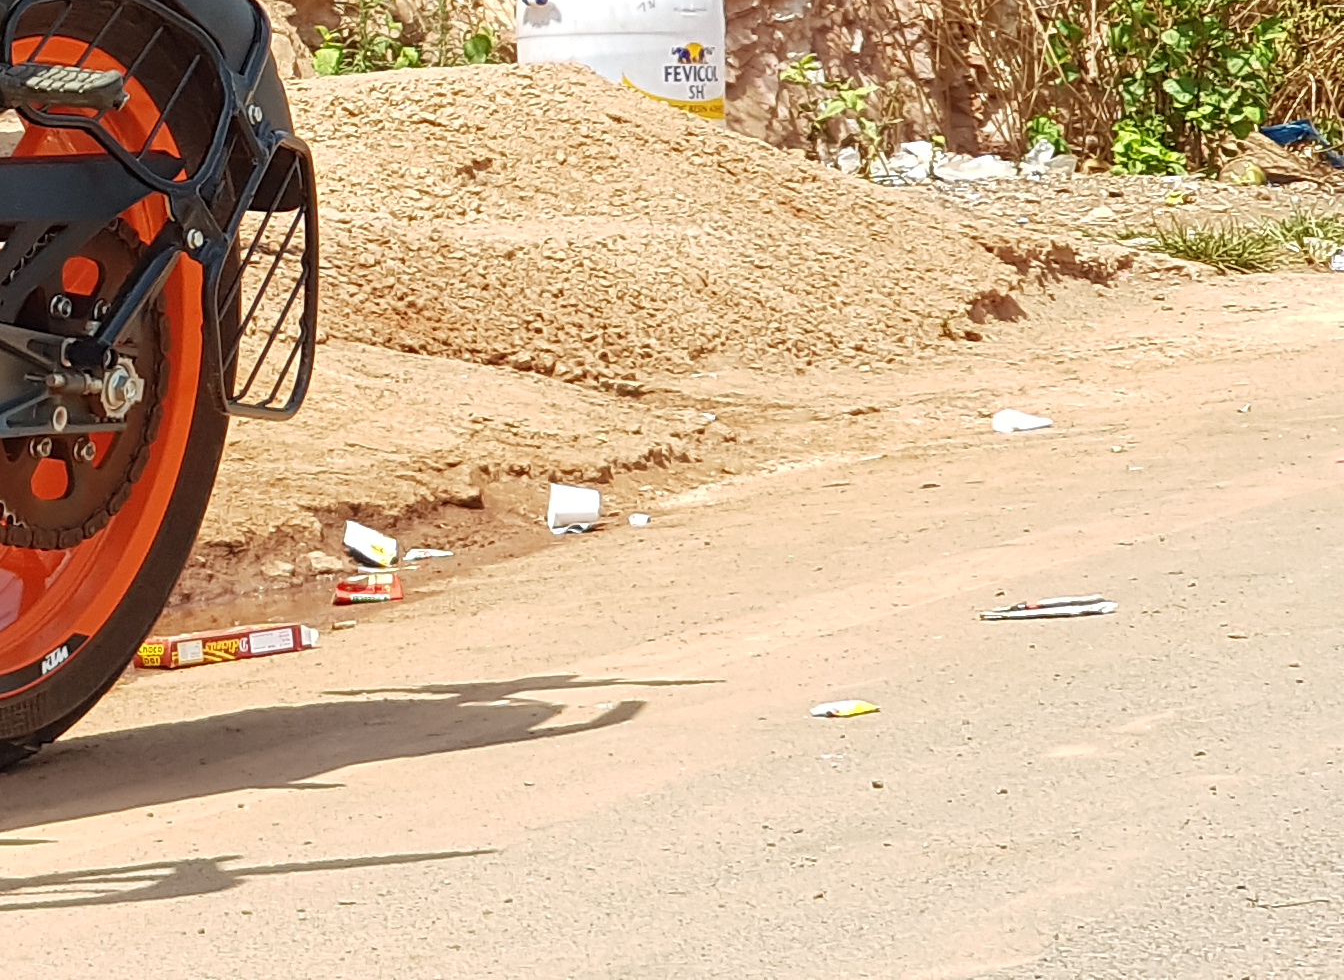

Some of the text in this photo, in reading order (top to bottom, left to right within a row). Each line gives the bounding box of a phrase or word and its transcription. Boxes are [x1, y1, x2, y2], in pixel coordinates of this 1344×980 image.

[664, 66, 718, 82] FEVICOL
[688, 85, 705, 99] SH
[41, 645, 69, 675] KTM
